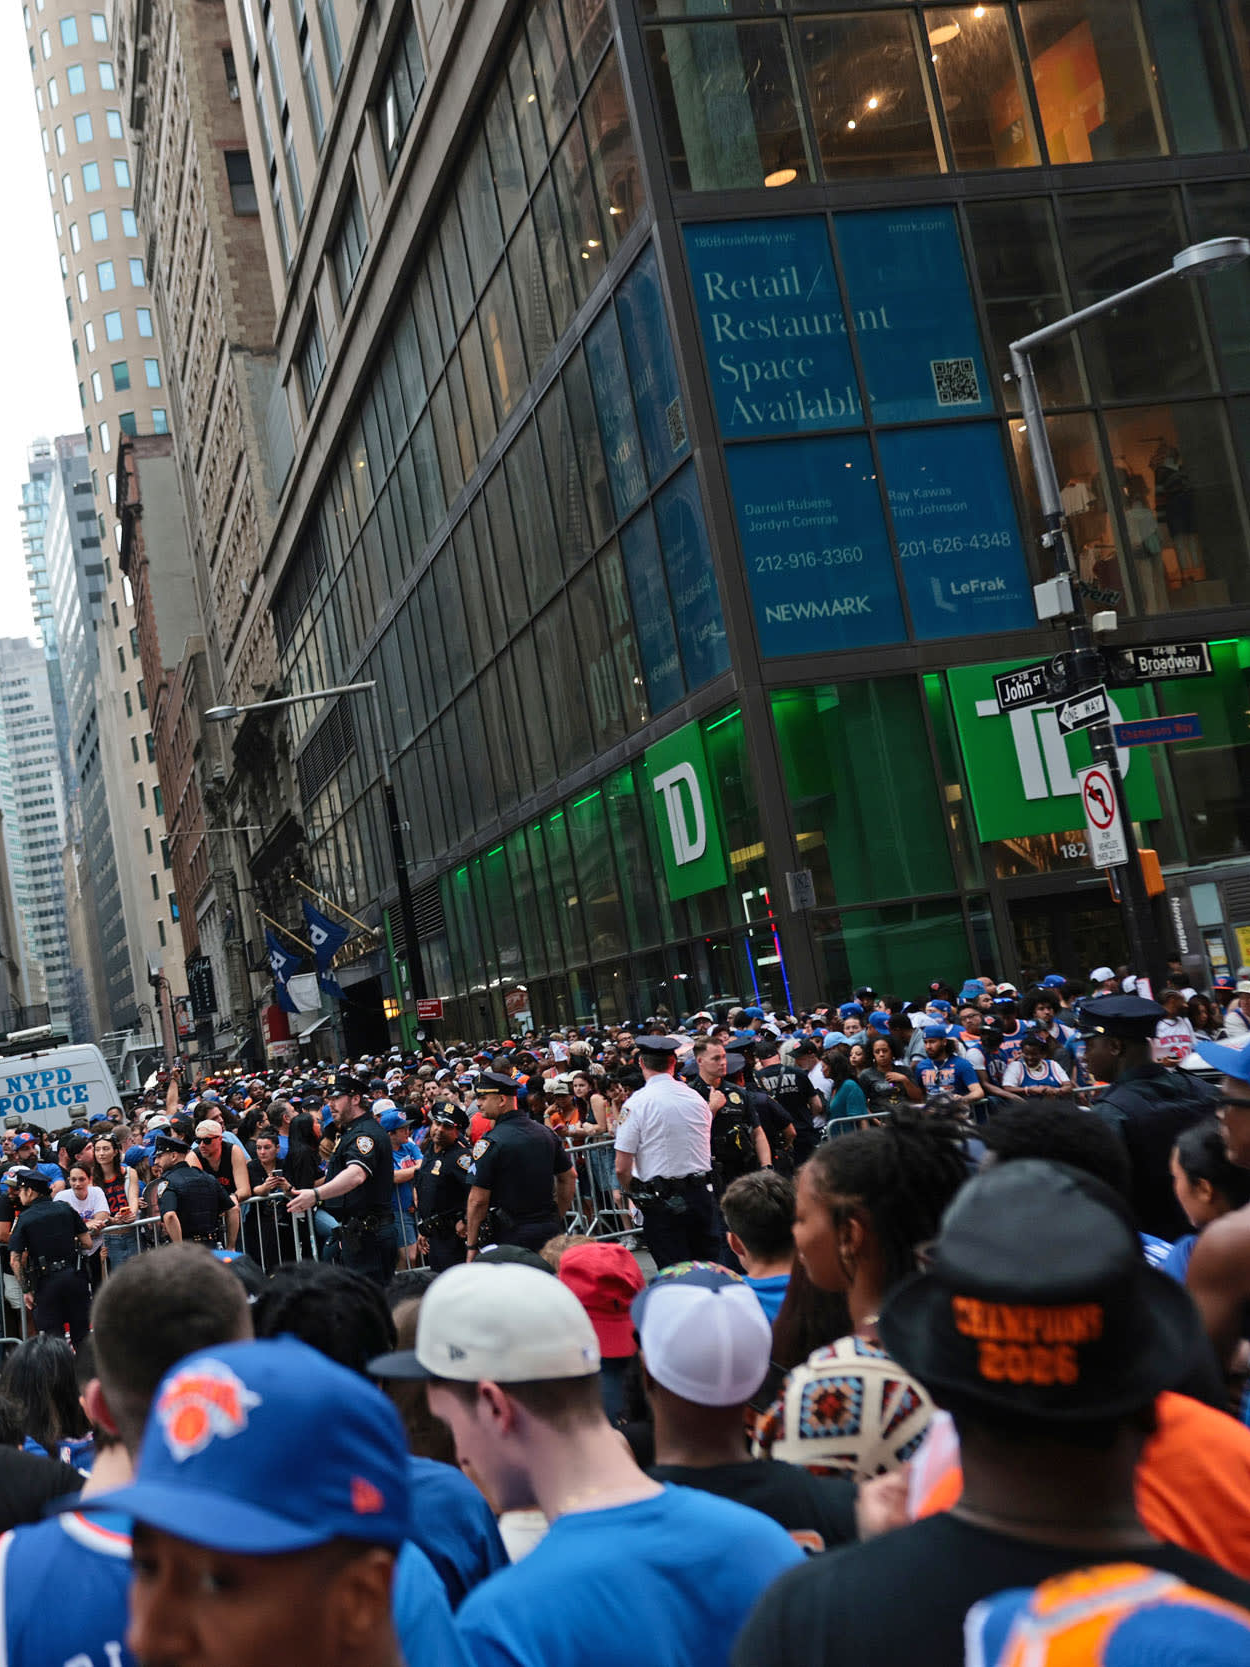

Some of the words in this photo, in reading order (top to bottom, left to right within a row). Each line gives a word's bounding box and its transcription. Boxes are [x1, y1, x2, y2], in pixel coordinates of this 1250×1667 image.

[703, 265, 801, 302] Retail
[718, 353, 815, 392] Space
[891, 506, 915, 519] Tim
[918, 500, 969, 515] Johnson
[899, 531, 1012, 558] 201-626-4348
[754, 546, 864, 573] 212-916-3360
[949, 576, 1007, 596] LeFrak
[765, 595, 873, 624] NEWMARK
[1137, 654, 1201, 672] Broadway
[1004, 680, 1034, 703] John
[1032, 674, 1042, 686] ST
[1063, 706, 1080, 724] ONE
[1085, 699, 1101, 715] WAY
[653, 761, 707, 867] TD
[1060, 841, 1088, 859] 182
[5, 1068, 72, 1094] NYPD
